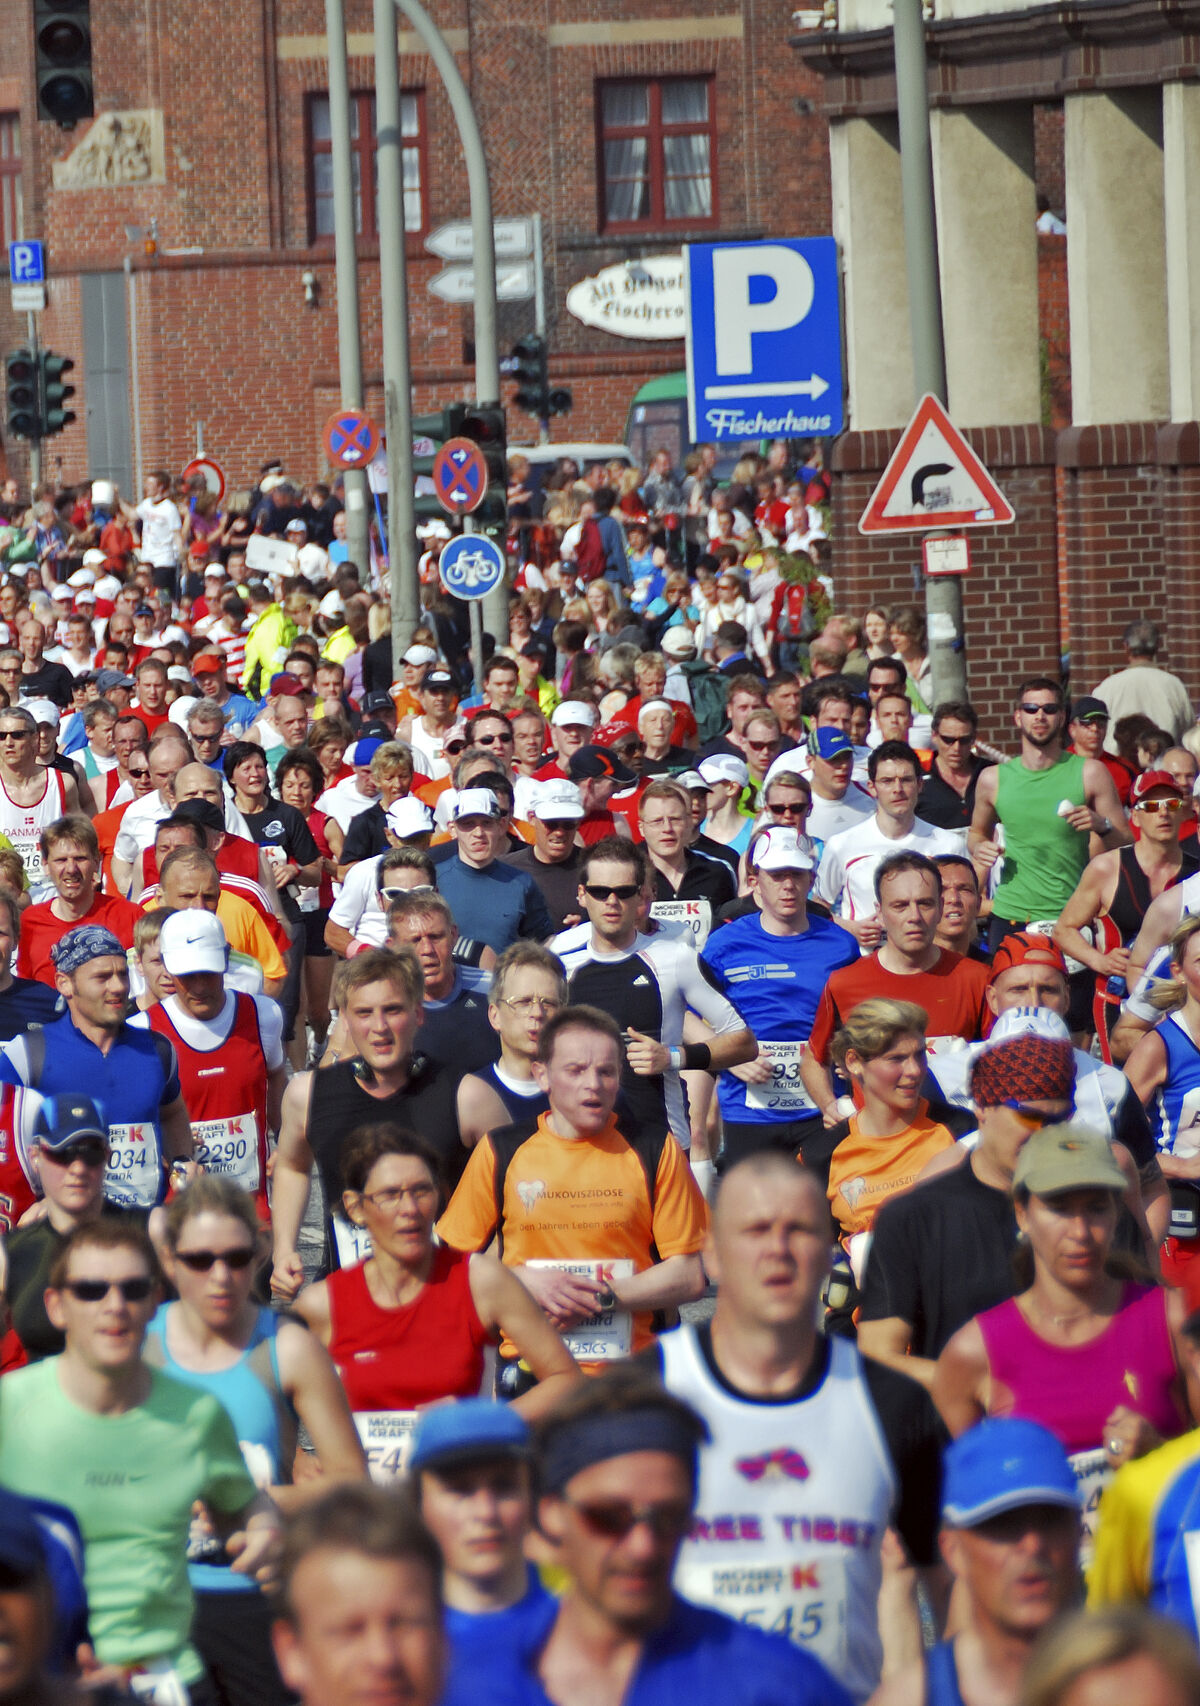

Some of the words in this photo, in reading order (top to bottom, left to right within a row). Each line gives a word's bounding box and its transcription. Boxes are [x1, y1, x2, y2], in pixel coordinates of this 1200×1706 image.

[712, 245, 815, 377] P
[705, 408, 831, 438] Fischerhaus
[536, 1188, 624, 1200] MUKOVISZIDOSE
[538, 1223, 569, 1232] Jahren
[572, 1221, 600, 1231] Leben
[774, 1512, 876, 1550] TIBET
